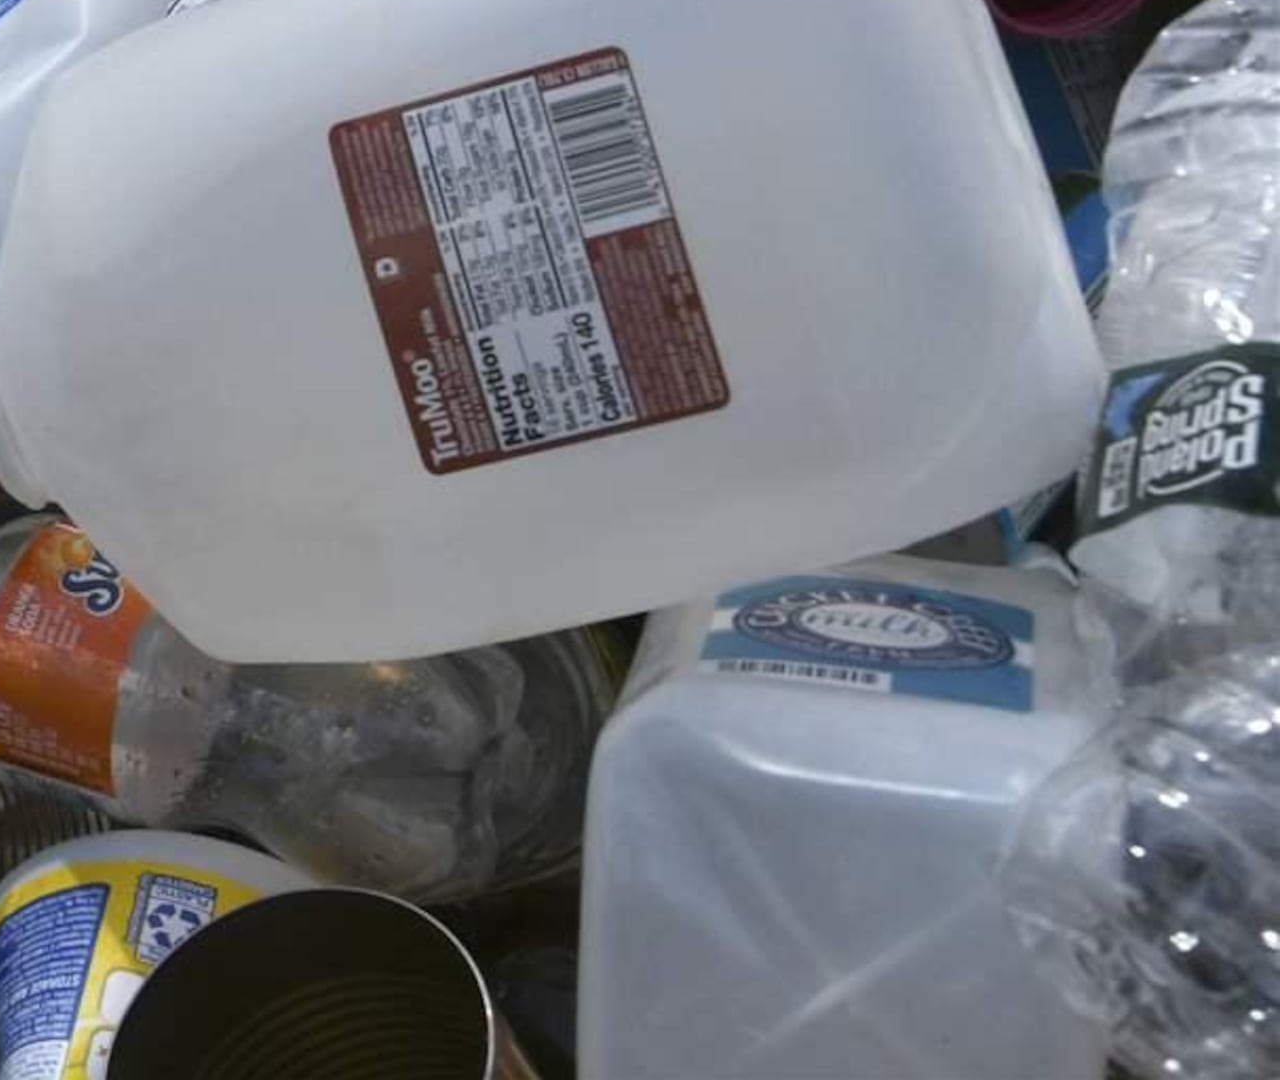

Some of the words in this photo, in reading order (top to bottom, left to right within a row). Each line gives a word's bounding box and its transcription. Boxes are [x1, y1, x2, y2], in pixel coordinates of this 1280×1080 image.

[570, 310, 602, 353] 140
[405, 356, 463, 465] TruMoo
[474, 334, 524, 449] Nutrition
[508, 370, 547, 444] Facts
[583, 350, 623, 425] Calories
[1142, 374, 1266, 451] Spring
[1137, 419, 1261, 497] Poland
[150, 892, 212, 912] PLASTIC
